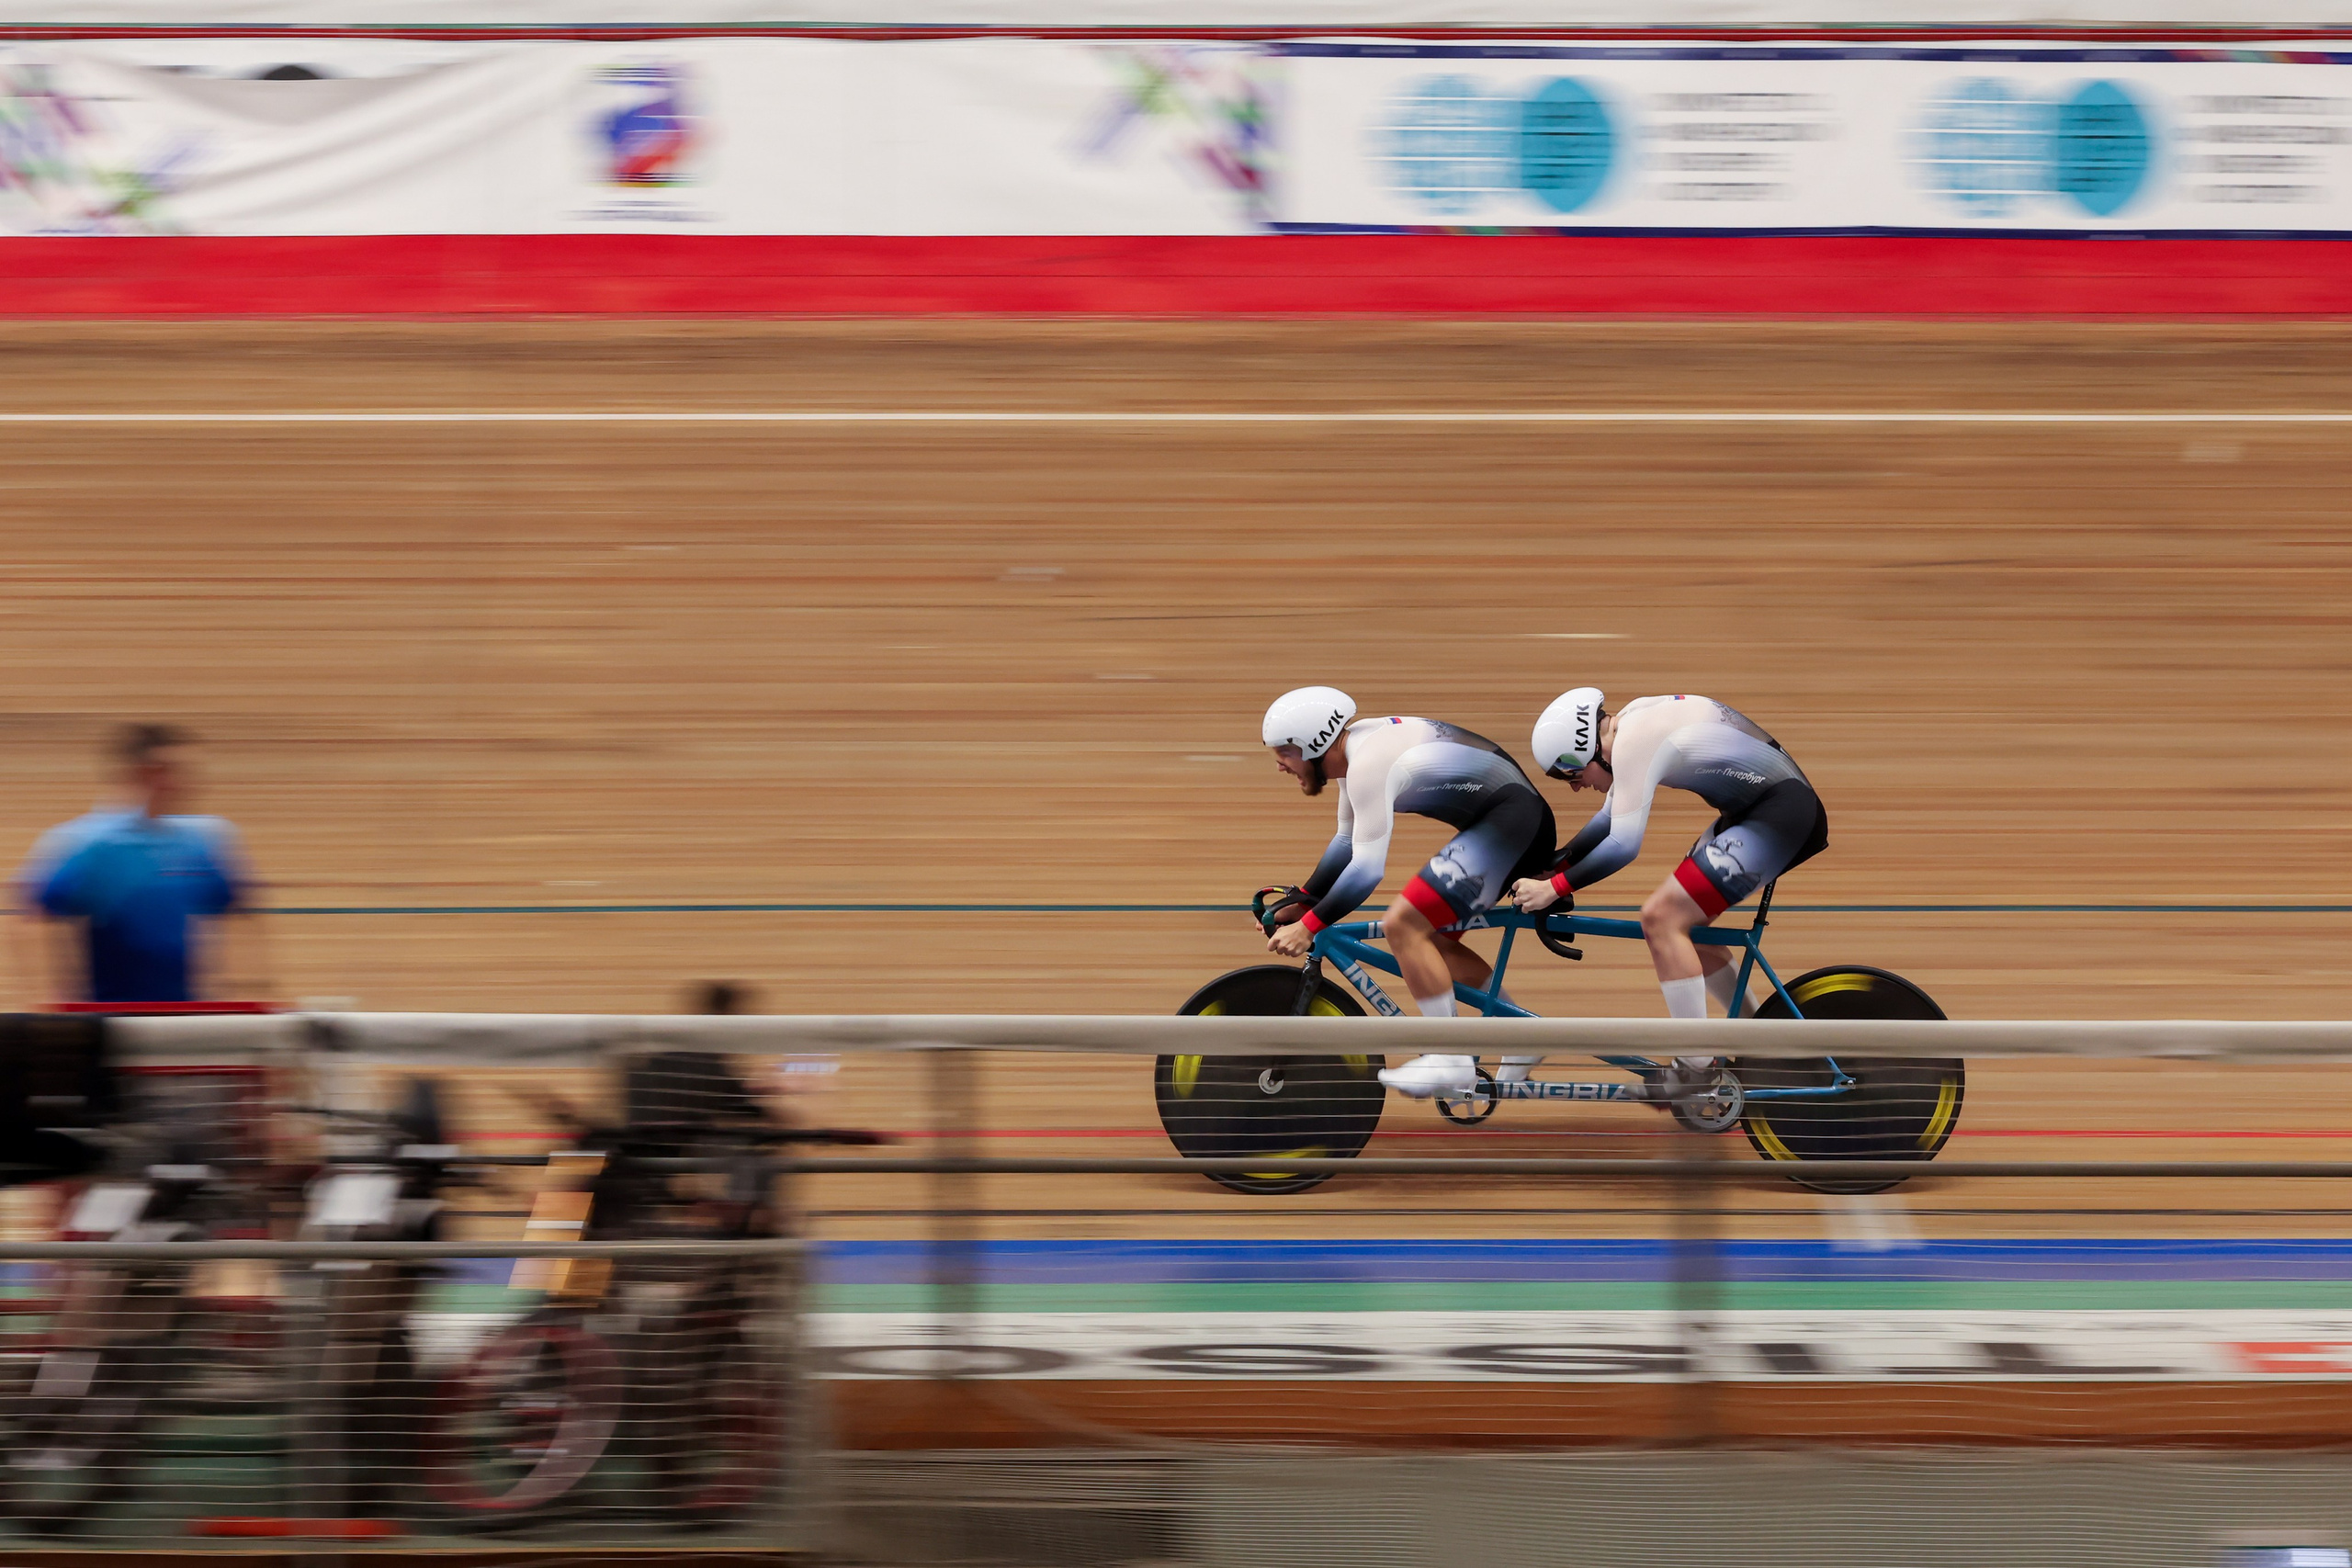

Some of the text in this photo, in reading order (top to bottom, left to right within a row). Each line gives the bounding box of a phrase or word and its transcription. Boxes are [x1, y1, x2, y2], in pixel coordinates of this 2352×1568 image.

[1307, 709, 1344, 753] KASK
[1575, 705, 1589, 751] KASK
[1691, 768, 1766, 784] Санкт-Петербург
